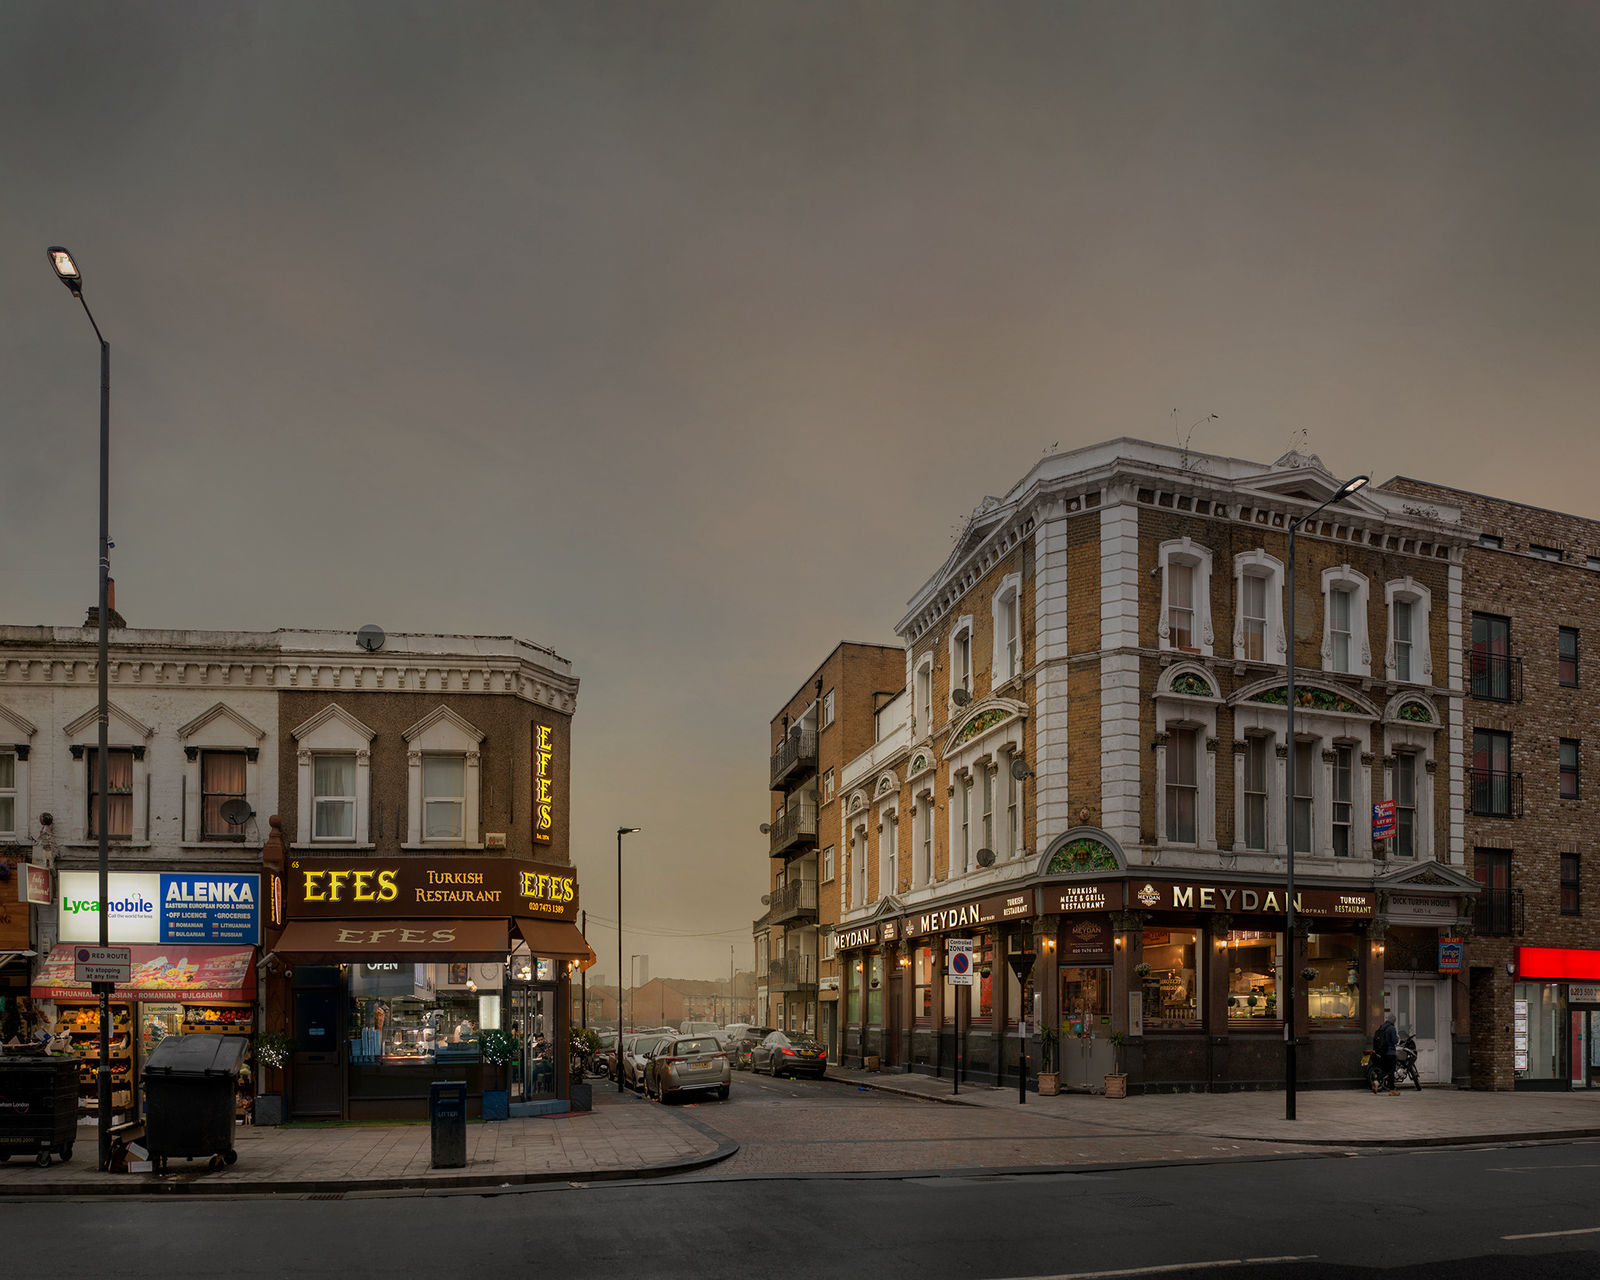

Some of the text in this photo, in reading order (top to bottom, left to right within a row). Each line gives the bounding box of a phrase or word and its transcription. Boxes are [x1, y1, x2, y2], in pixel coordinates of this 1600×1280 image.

[536, 725, 553, 830] EFES
[291, 861, 299, 869] 65
[426, 870, 484, 884] TURKISH
[303, 868, 400, 903] EFES
[520, 870, 575, 902] EFES
[1067, 886, 1098, 895] TURKISH
[165, 881, 255, 903] ALENKA
[415, 888, 502, 902] RESTAURANT
[1060, 893, 1106, 903] MEZE & GRILL
[1172, 885, 1303, 914] MEYDAN
[1339, 896, 1366, 905] TURKISH
[1392, 896, 1451, 907] DICK TURPIN HOUSE
[528, 902, 539, 911] 020
[1060, 901, 1105, 910] RESTAURANT
[1334, 905, 1372, 914] RESTAURANT
[920, 903, 981, 934] MEYDAN
[336, 927, 457, 944] EFES
[1072, 926, 1102, 935] MEYDAN
[834, 928, 870, 950] MEYDAN
[106, 953, 128, 961] ROUTE
[367, 961, 399, 970] OPEN
[94, 967, 121, 975] stopping
[182, 991, 223, 999] BULGARIAN
